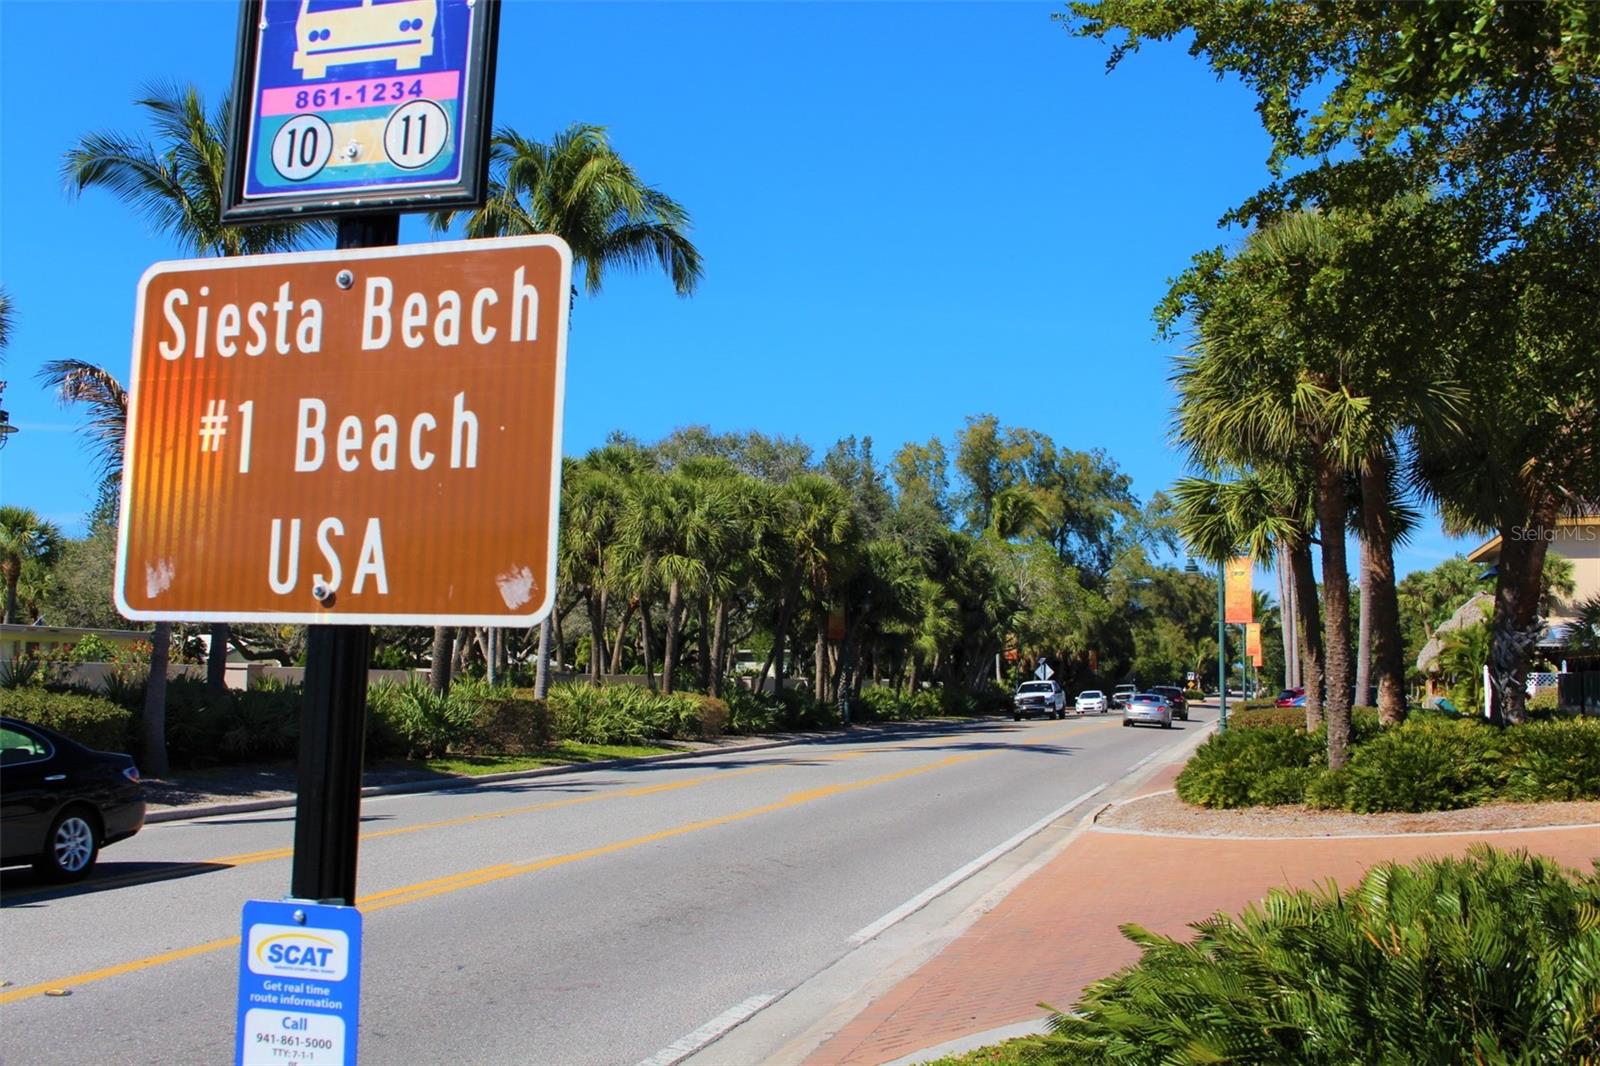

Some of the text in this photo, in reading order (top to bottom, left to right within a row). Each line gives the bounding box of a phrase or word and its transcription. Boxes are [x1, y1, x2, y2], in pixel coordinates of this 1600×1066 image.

[295, 79, 423, 109] 861-1234
[287, 126, 318, 168] 10
[402, 113, 428, 155] 11
[158, 265, 539, 360] Siesta Beach
[199, 391, 479, 474] #1 Beach
[268, 517, 389, 595] USA
[268, 944, 333, 967] SCAT
[250, 993, 342, 1009] route information
[263, 980, 331, 996] Get real time
[282, 1016, 308, 1031] Call
[256, 1033, 332, 1049] 941-861-5000
